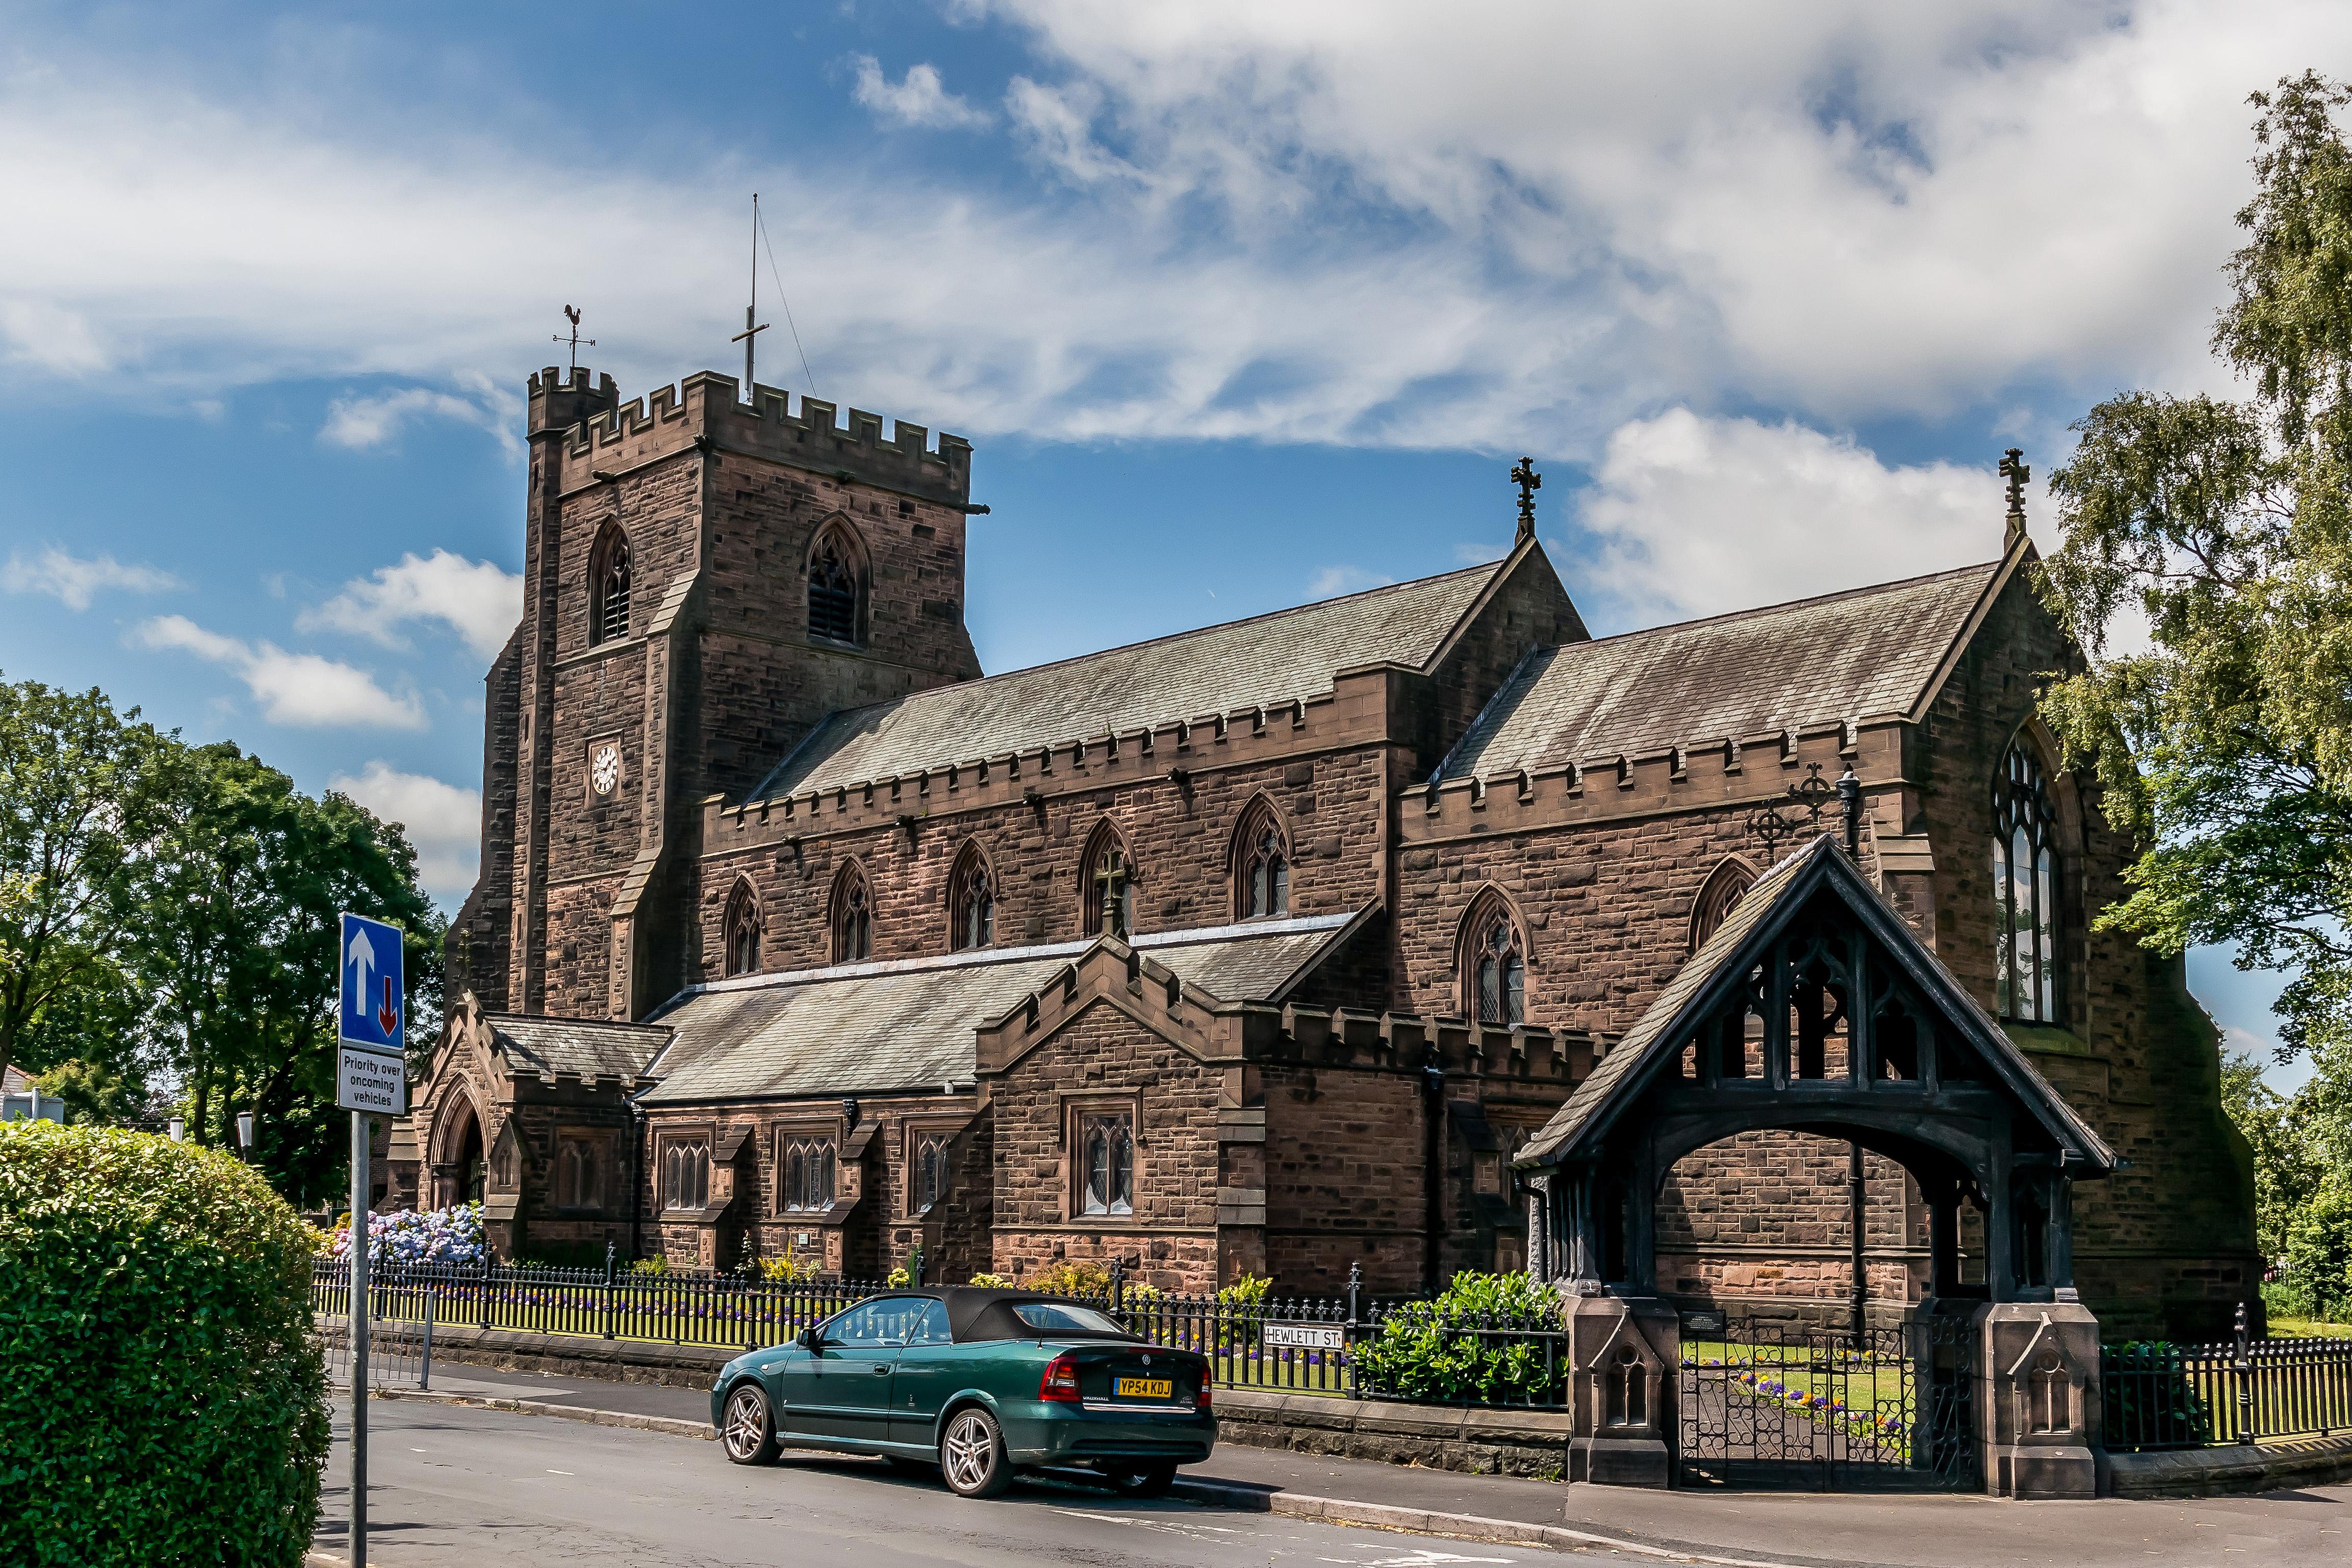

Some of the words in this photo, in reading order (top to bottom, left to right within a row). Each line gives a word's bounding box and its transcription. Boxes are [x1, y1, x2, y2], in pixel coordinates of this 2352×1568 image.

[344, 1056, 378, 1075] Priority
[381, 1064, 400, 1076] over
[350, 1075, 395, 1093] oncoming
[354, 1091, 392, 1106] vehicles
[1267, 1328, 1317, 1345] HEWLETT
[1122, 1380, 1148, 1394] YP54
[1151, 1381, 1170, 1395] KDJ
